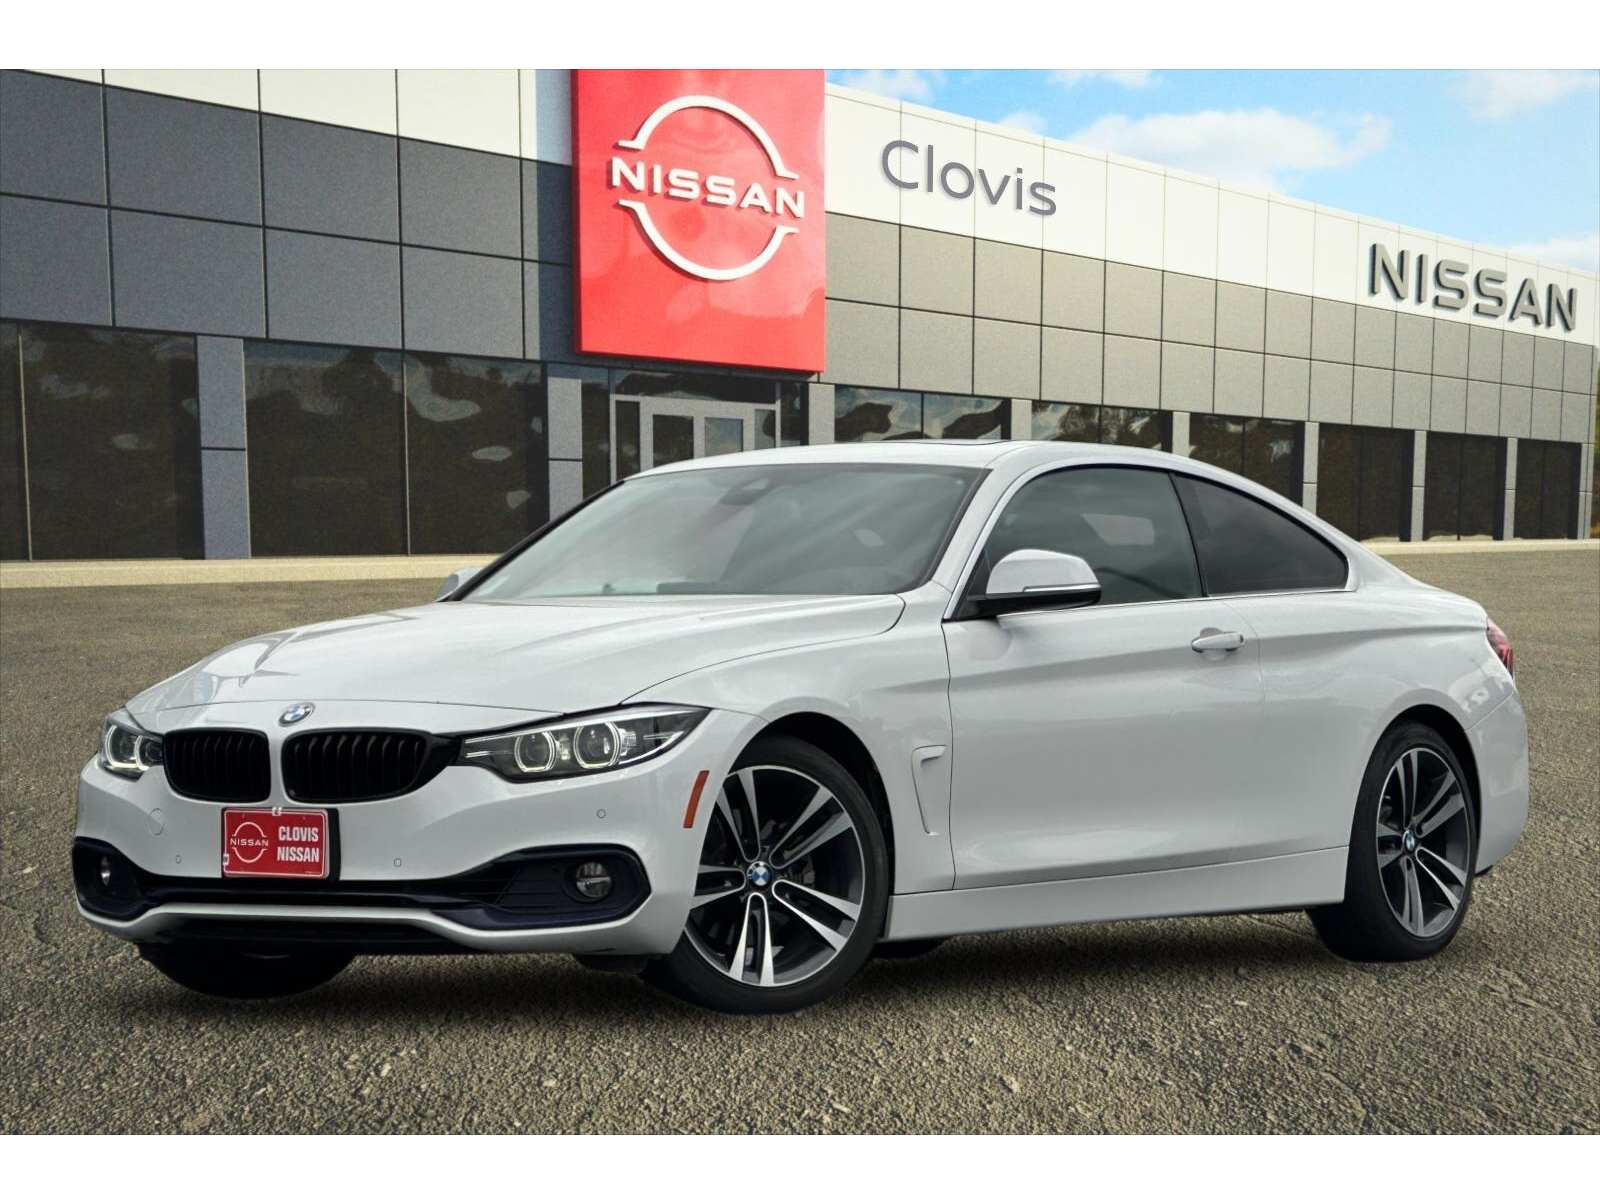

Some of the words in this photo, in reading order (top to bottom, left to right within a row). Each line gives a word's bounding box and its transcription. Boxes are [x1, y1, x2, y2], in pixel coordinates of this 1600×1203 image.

[610, 156, 805, 218] NISSAN
[881, 140, 1057, 216] Clovis
[1369, 243, 1578, 332] NISSAN
[230, 838, 269, 847] NISSAN
[278, 826, 319, 842] CLOVIS
[277, 846, 320, 863] NISSAN
